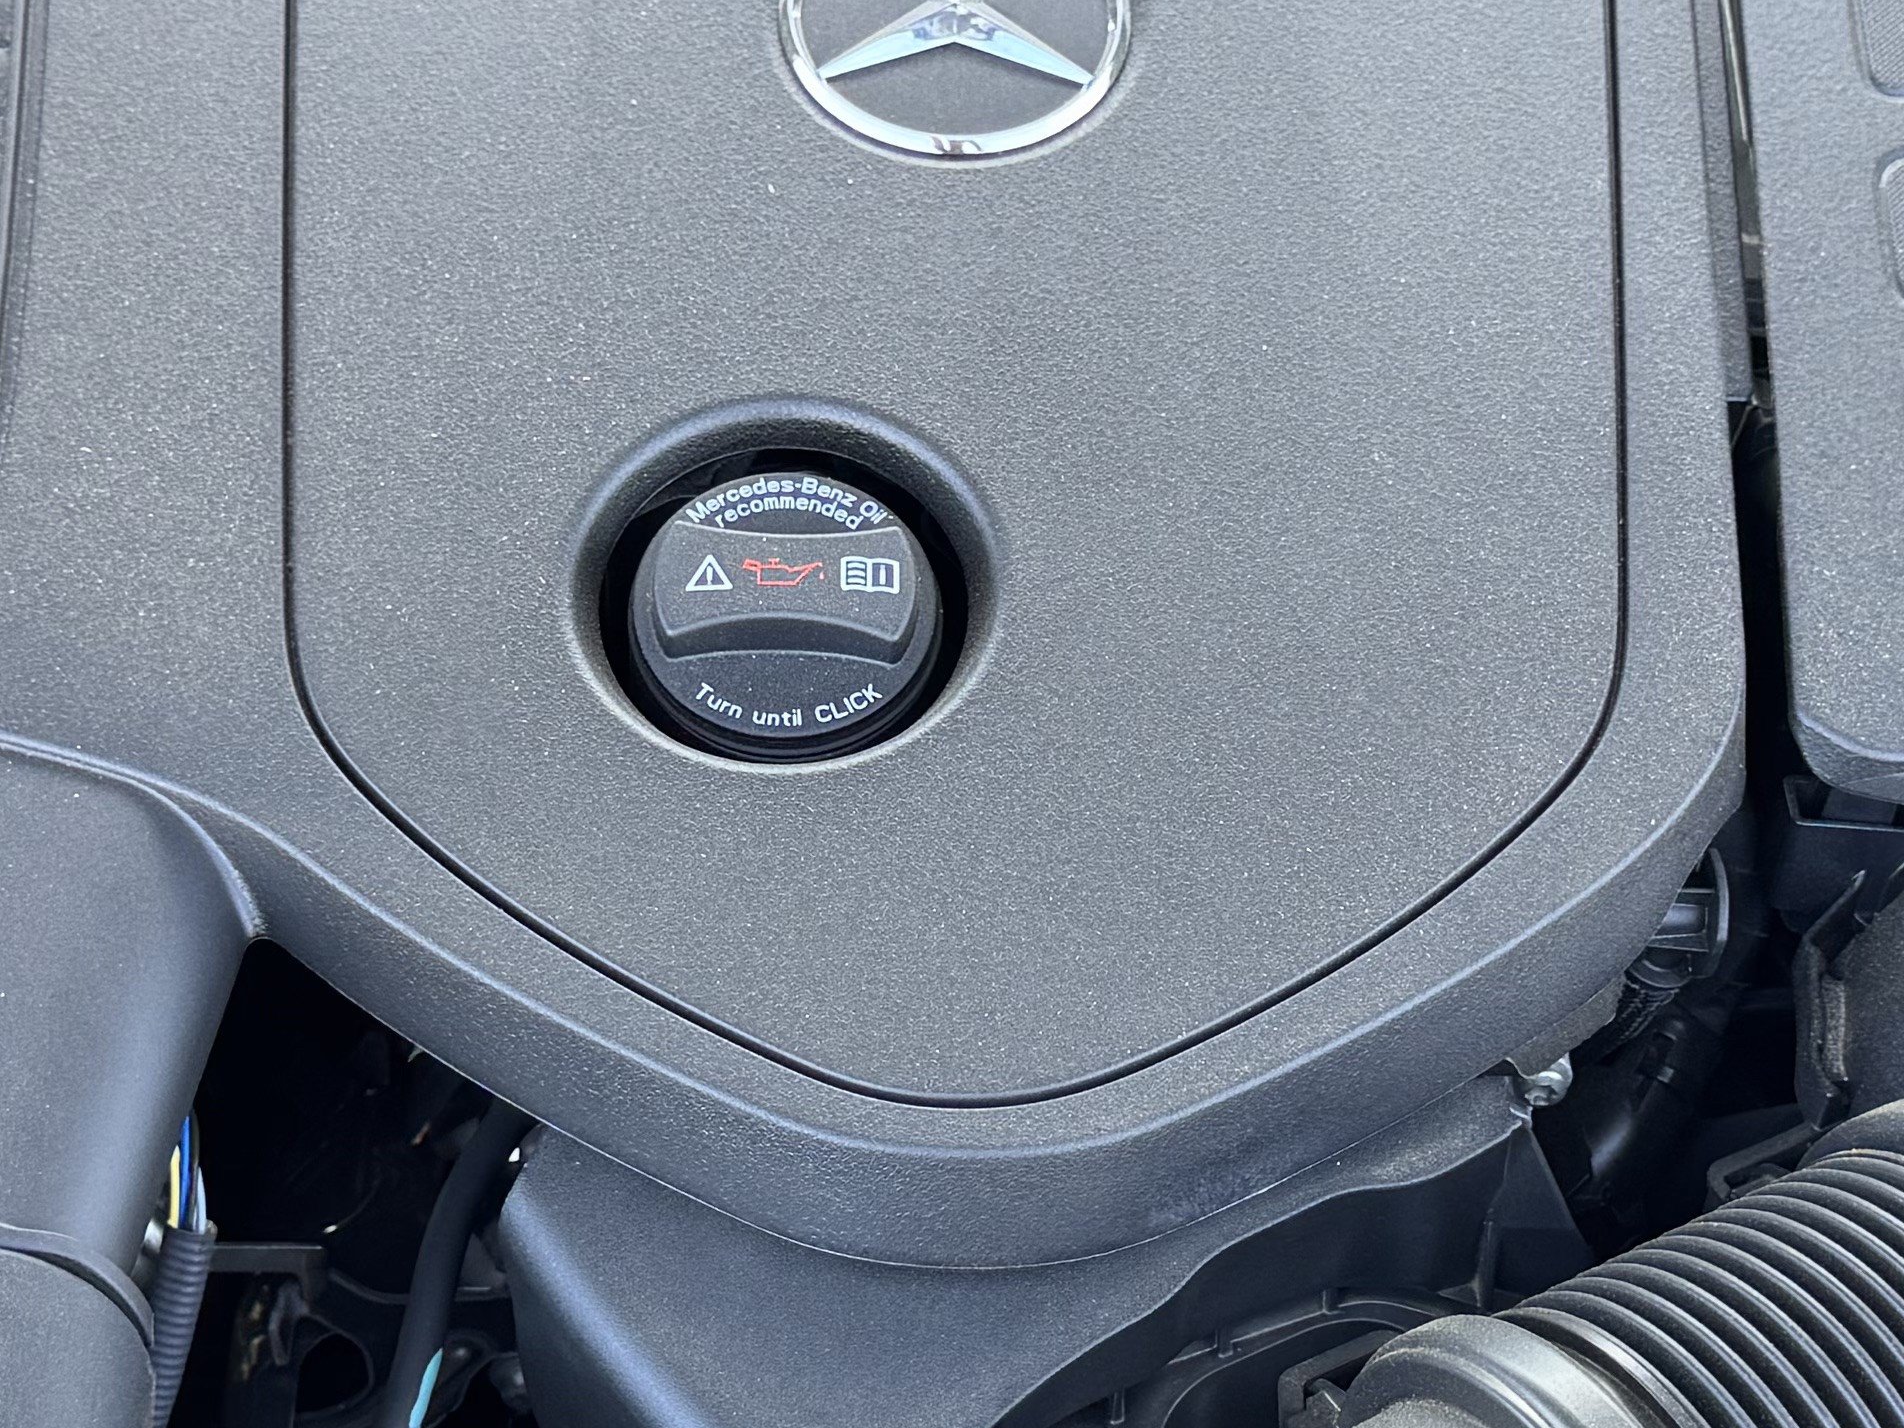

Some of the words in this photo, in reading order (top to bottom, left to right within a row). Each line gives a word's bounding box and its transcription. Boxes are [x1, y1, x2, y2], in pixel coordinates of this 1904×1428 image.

[686, 477, 858, 523] Mercedes-Benz
[715, 494, 864, 531] recommended
[695, 682, 743, 720] Turn
[752, 708, 803, 727] until
[814, 683, 884, 724] CLICK
